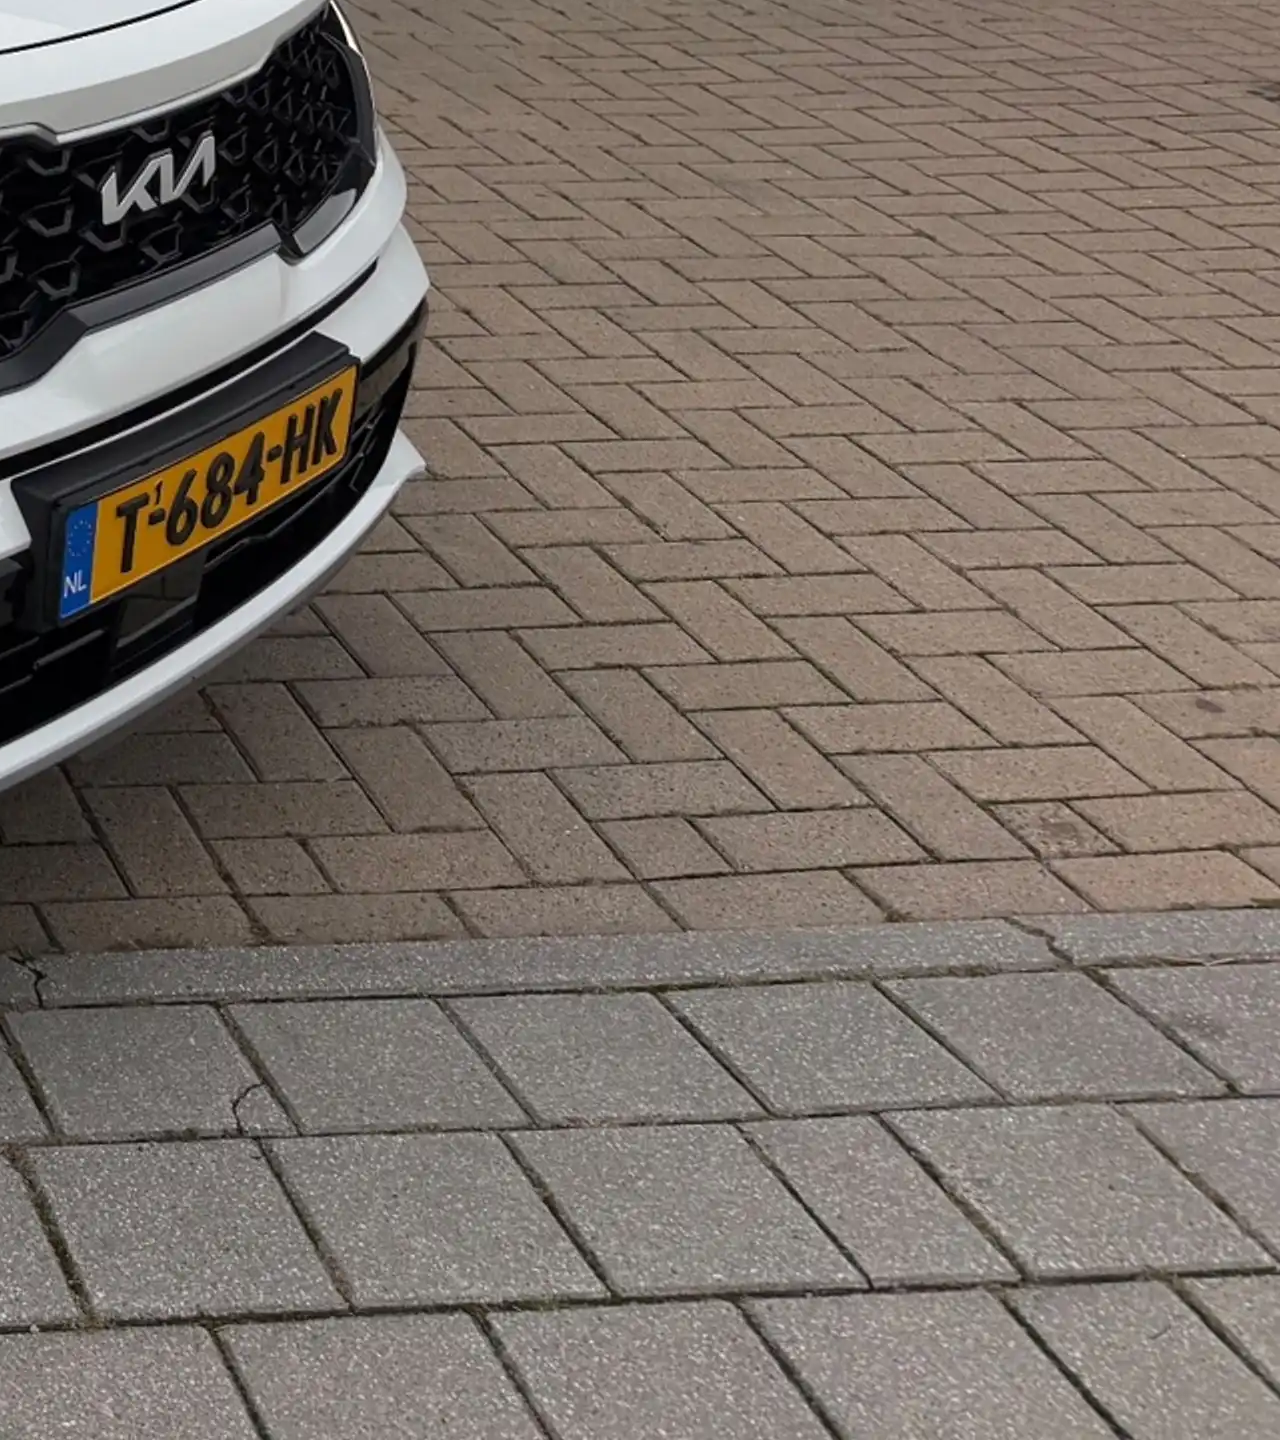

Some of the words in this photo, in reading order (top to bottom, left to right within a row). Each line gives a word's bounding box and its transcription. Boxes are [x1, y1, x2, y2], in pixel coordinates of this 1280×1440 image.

[101, 130, 216, 226] KIA
[115, 388, 343, 574] T-684-HK
[63, 572, 87, 599] NL
